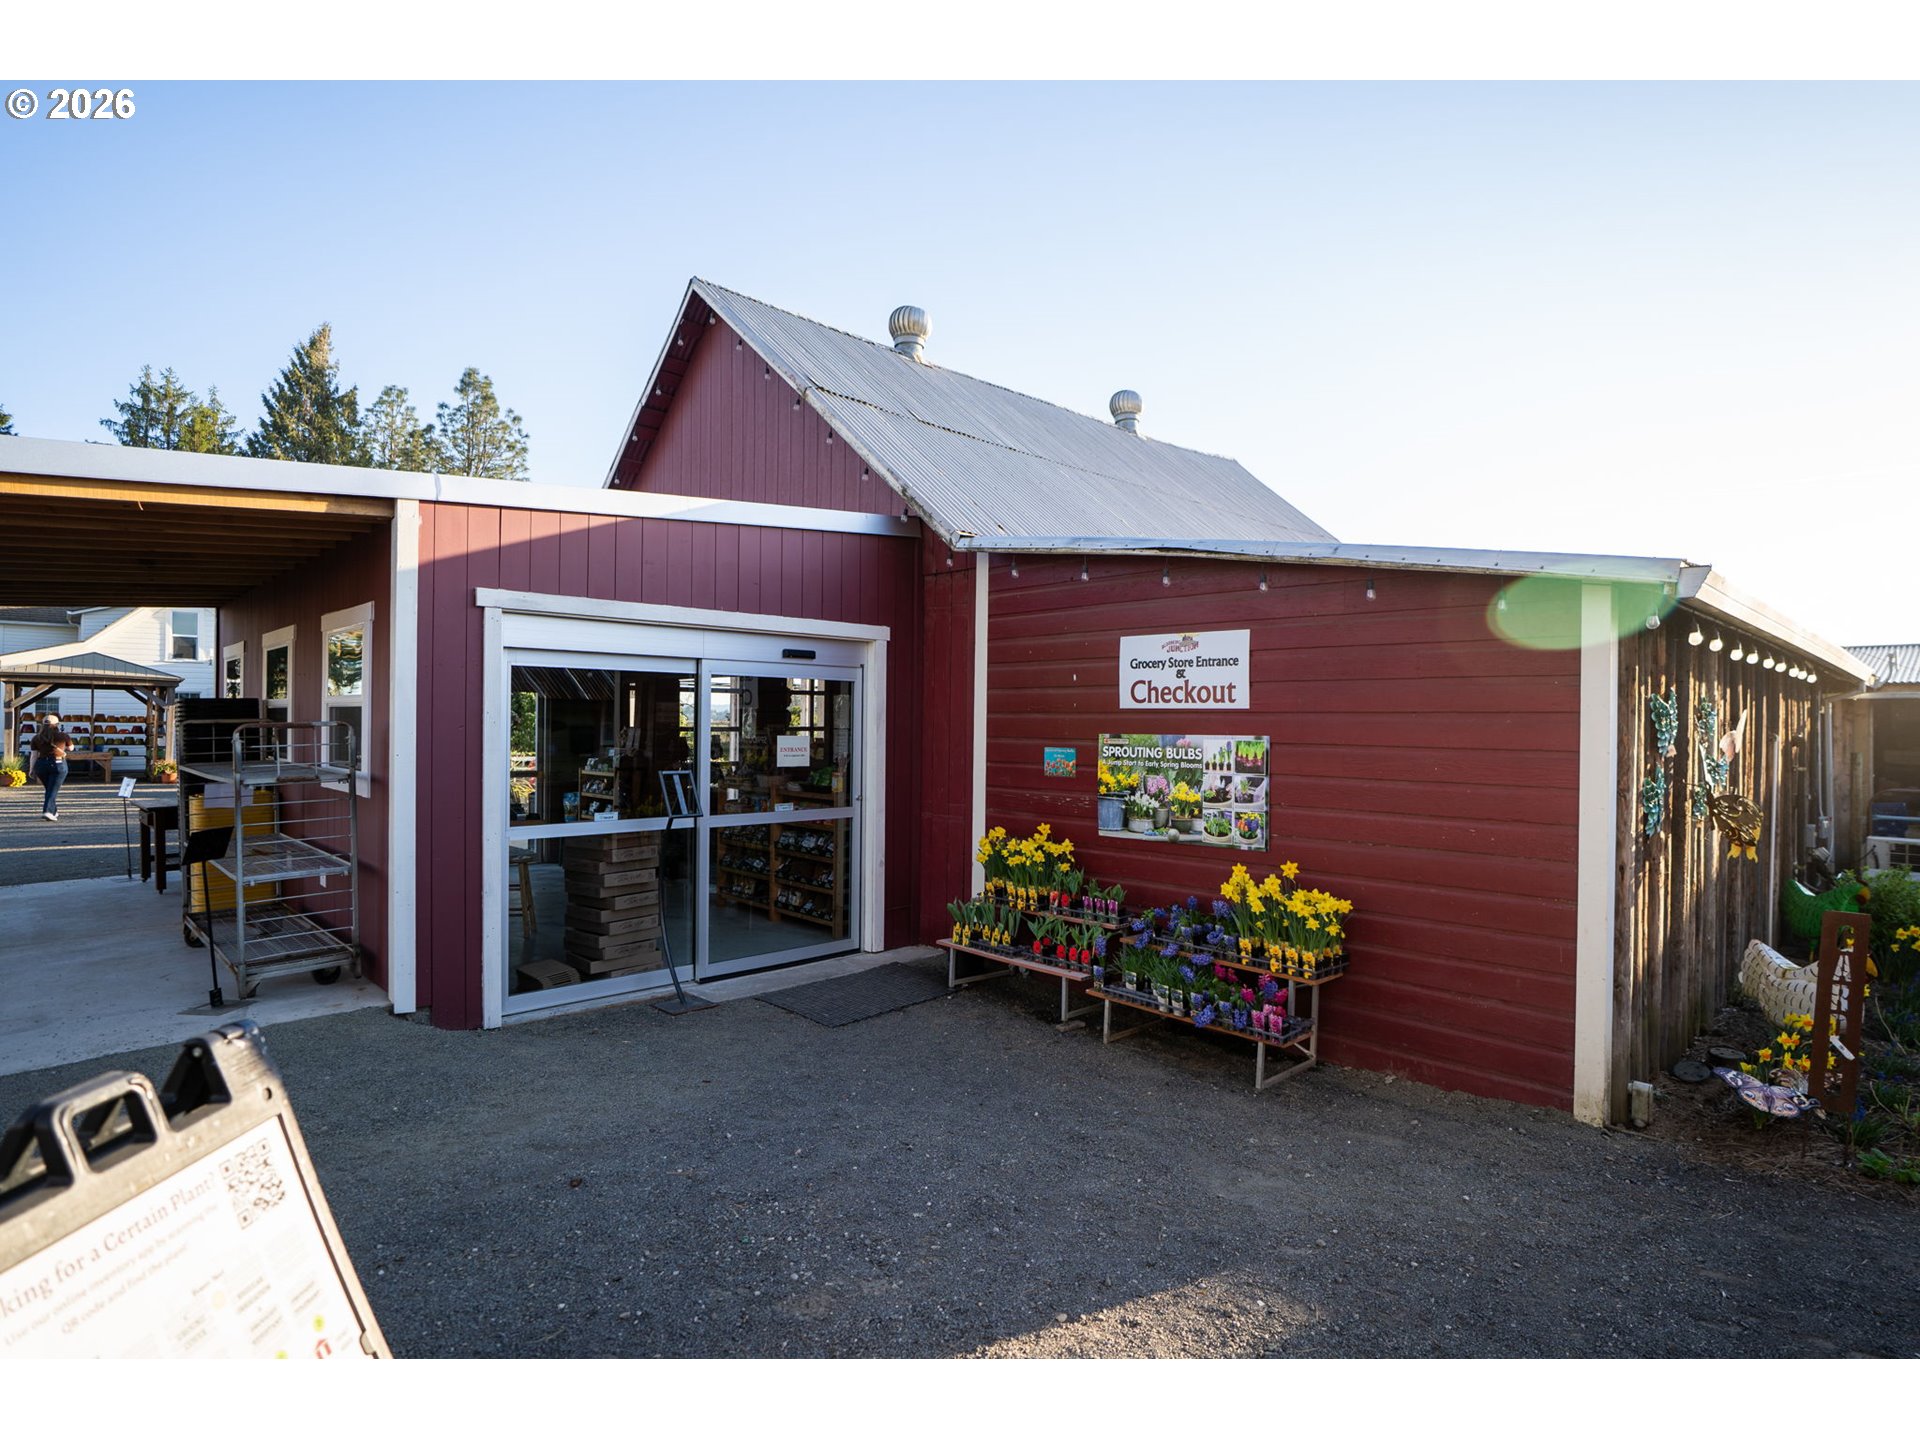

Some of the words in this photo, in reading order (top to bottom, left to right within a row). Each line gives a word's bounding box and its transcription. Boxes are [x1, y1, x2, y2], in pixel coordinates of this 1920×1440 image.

[1166, 641, 1200, 653] JUNCTION
[1130, 658, 1167, 671] Grocery
[1168, 657, 1194, 668] Store
[1196, 656, 1239, 668] Entrance
[1175, 669, 1186, 679] &
[1130, 679, 1237, 704] Checkout
[1102, 746, 1163, 759] SPROUTING
[1166, 748, 1203, 760] BULBS
[1160, 761, 1179, 769] Spring
[55, 1257, 86, 1284] for
[91, 1248, 101, 1263] a
[103, 1206, 169, 1252] Certain
